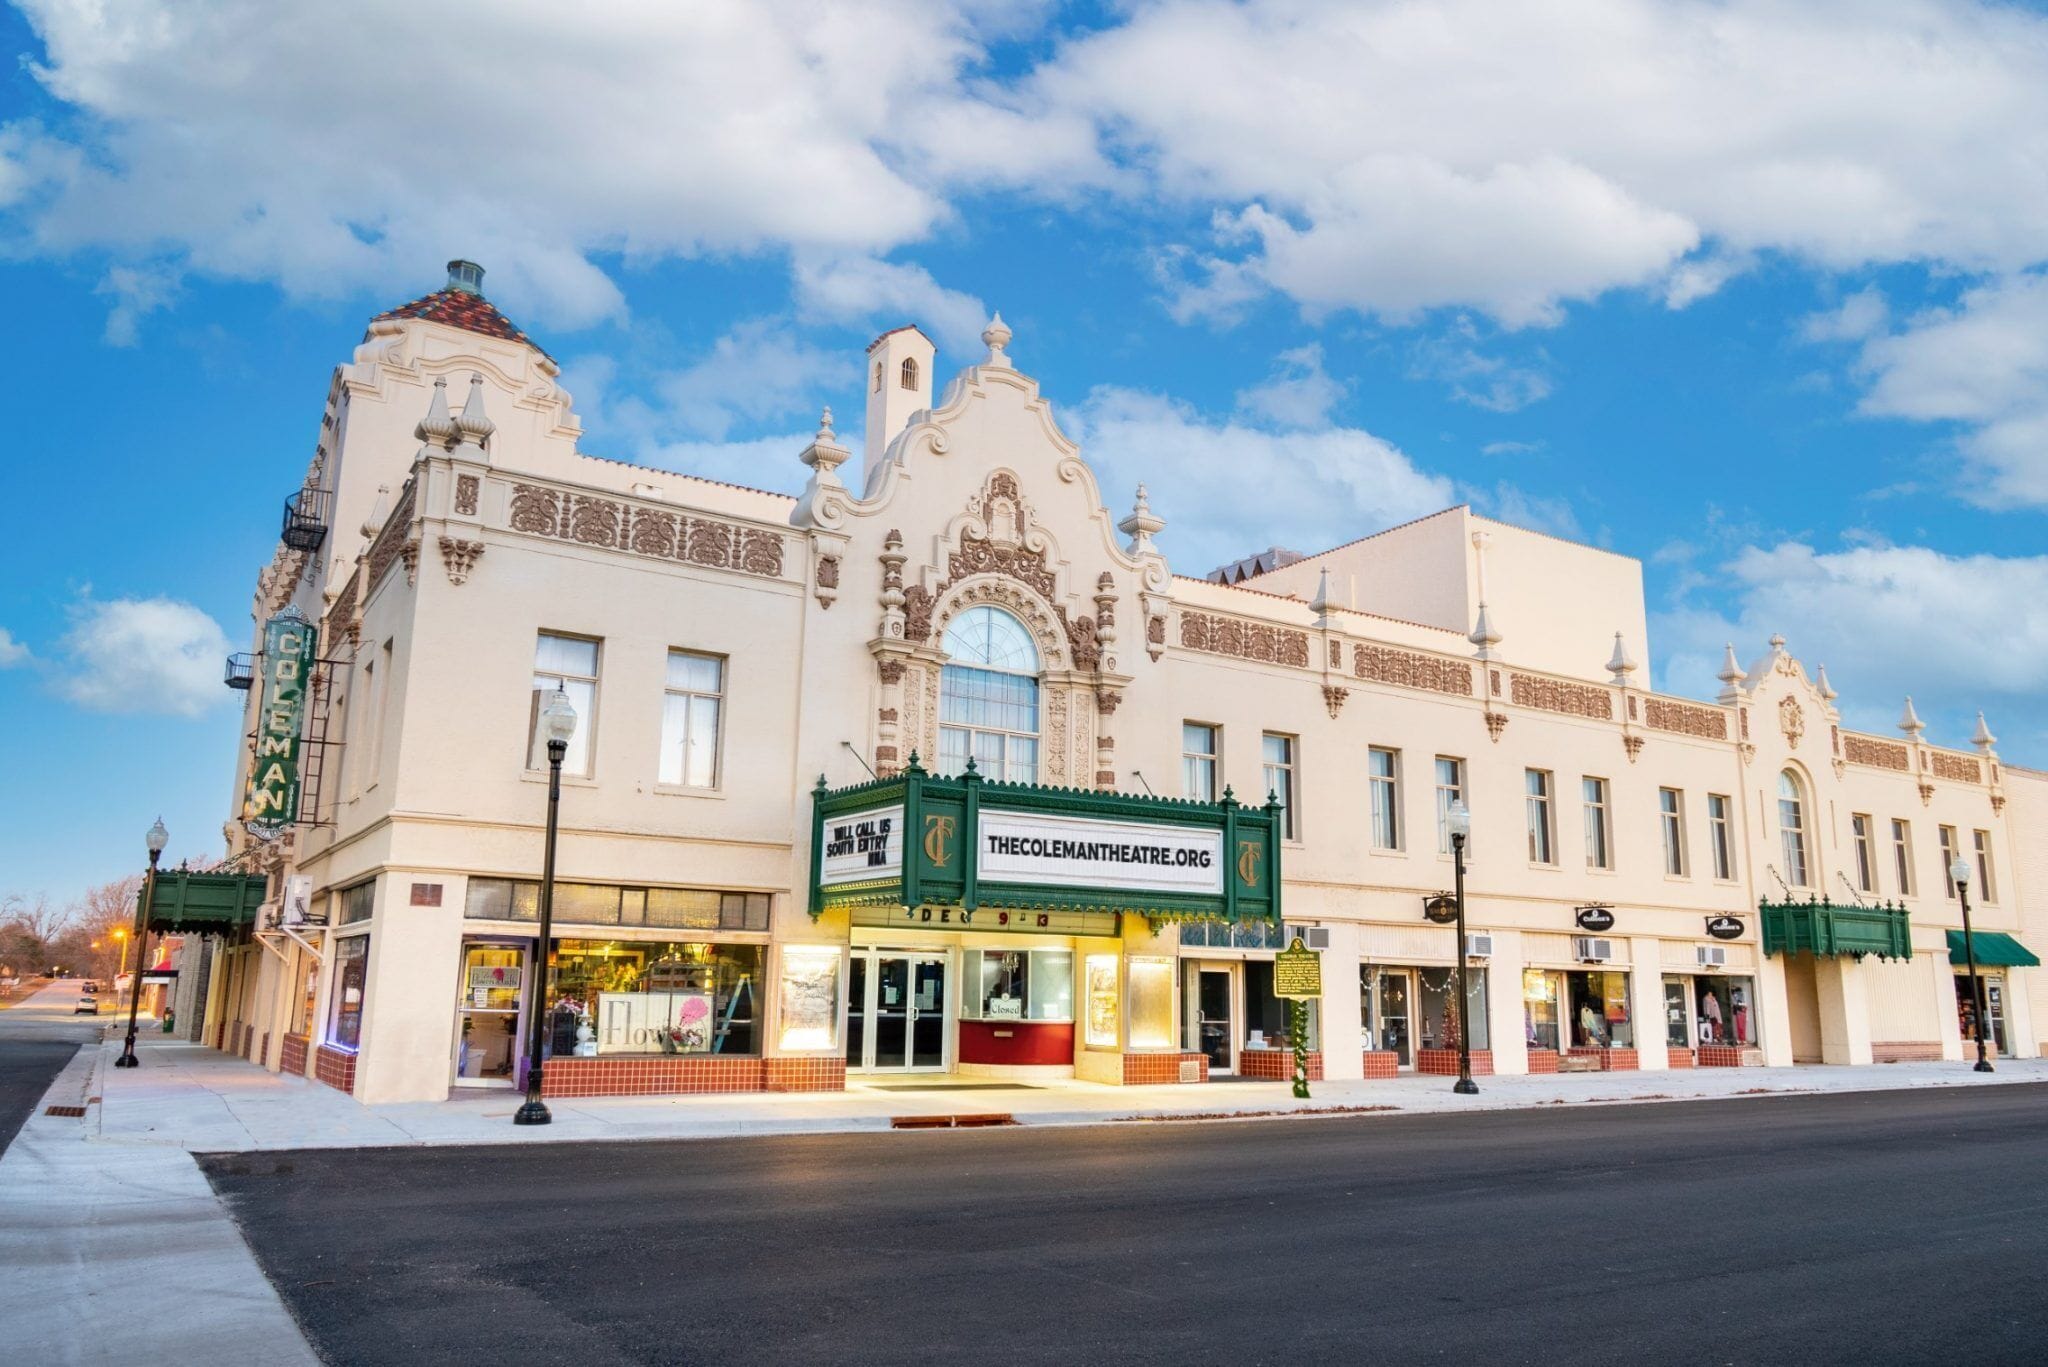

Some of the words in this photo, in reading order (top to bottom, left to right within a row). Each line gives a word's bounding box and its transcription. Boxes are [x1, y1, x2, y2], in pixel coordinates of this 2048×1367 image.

[260, 633, 302, 811] COLEMAN
[856, 821, 876, 837] CALL
[827, 840, 854, 858] SOUTH
[858, 834, 888, 853] ENTRY
[988, 836, 1211, 868] THECOLEMANTHEATRE.ORG
[998, 912, 1008, 925] 9
[991, 1004, 1020, 1014] Closed
[603, 1000, 704, 1047] Flows
